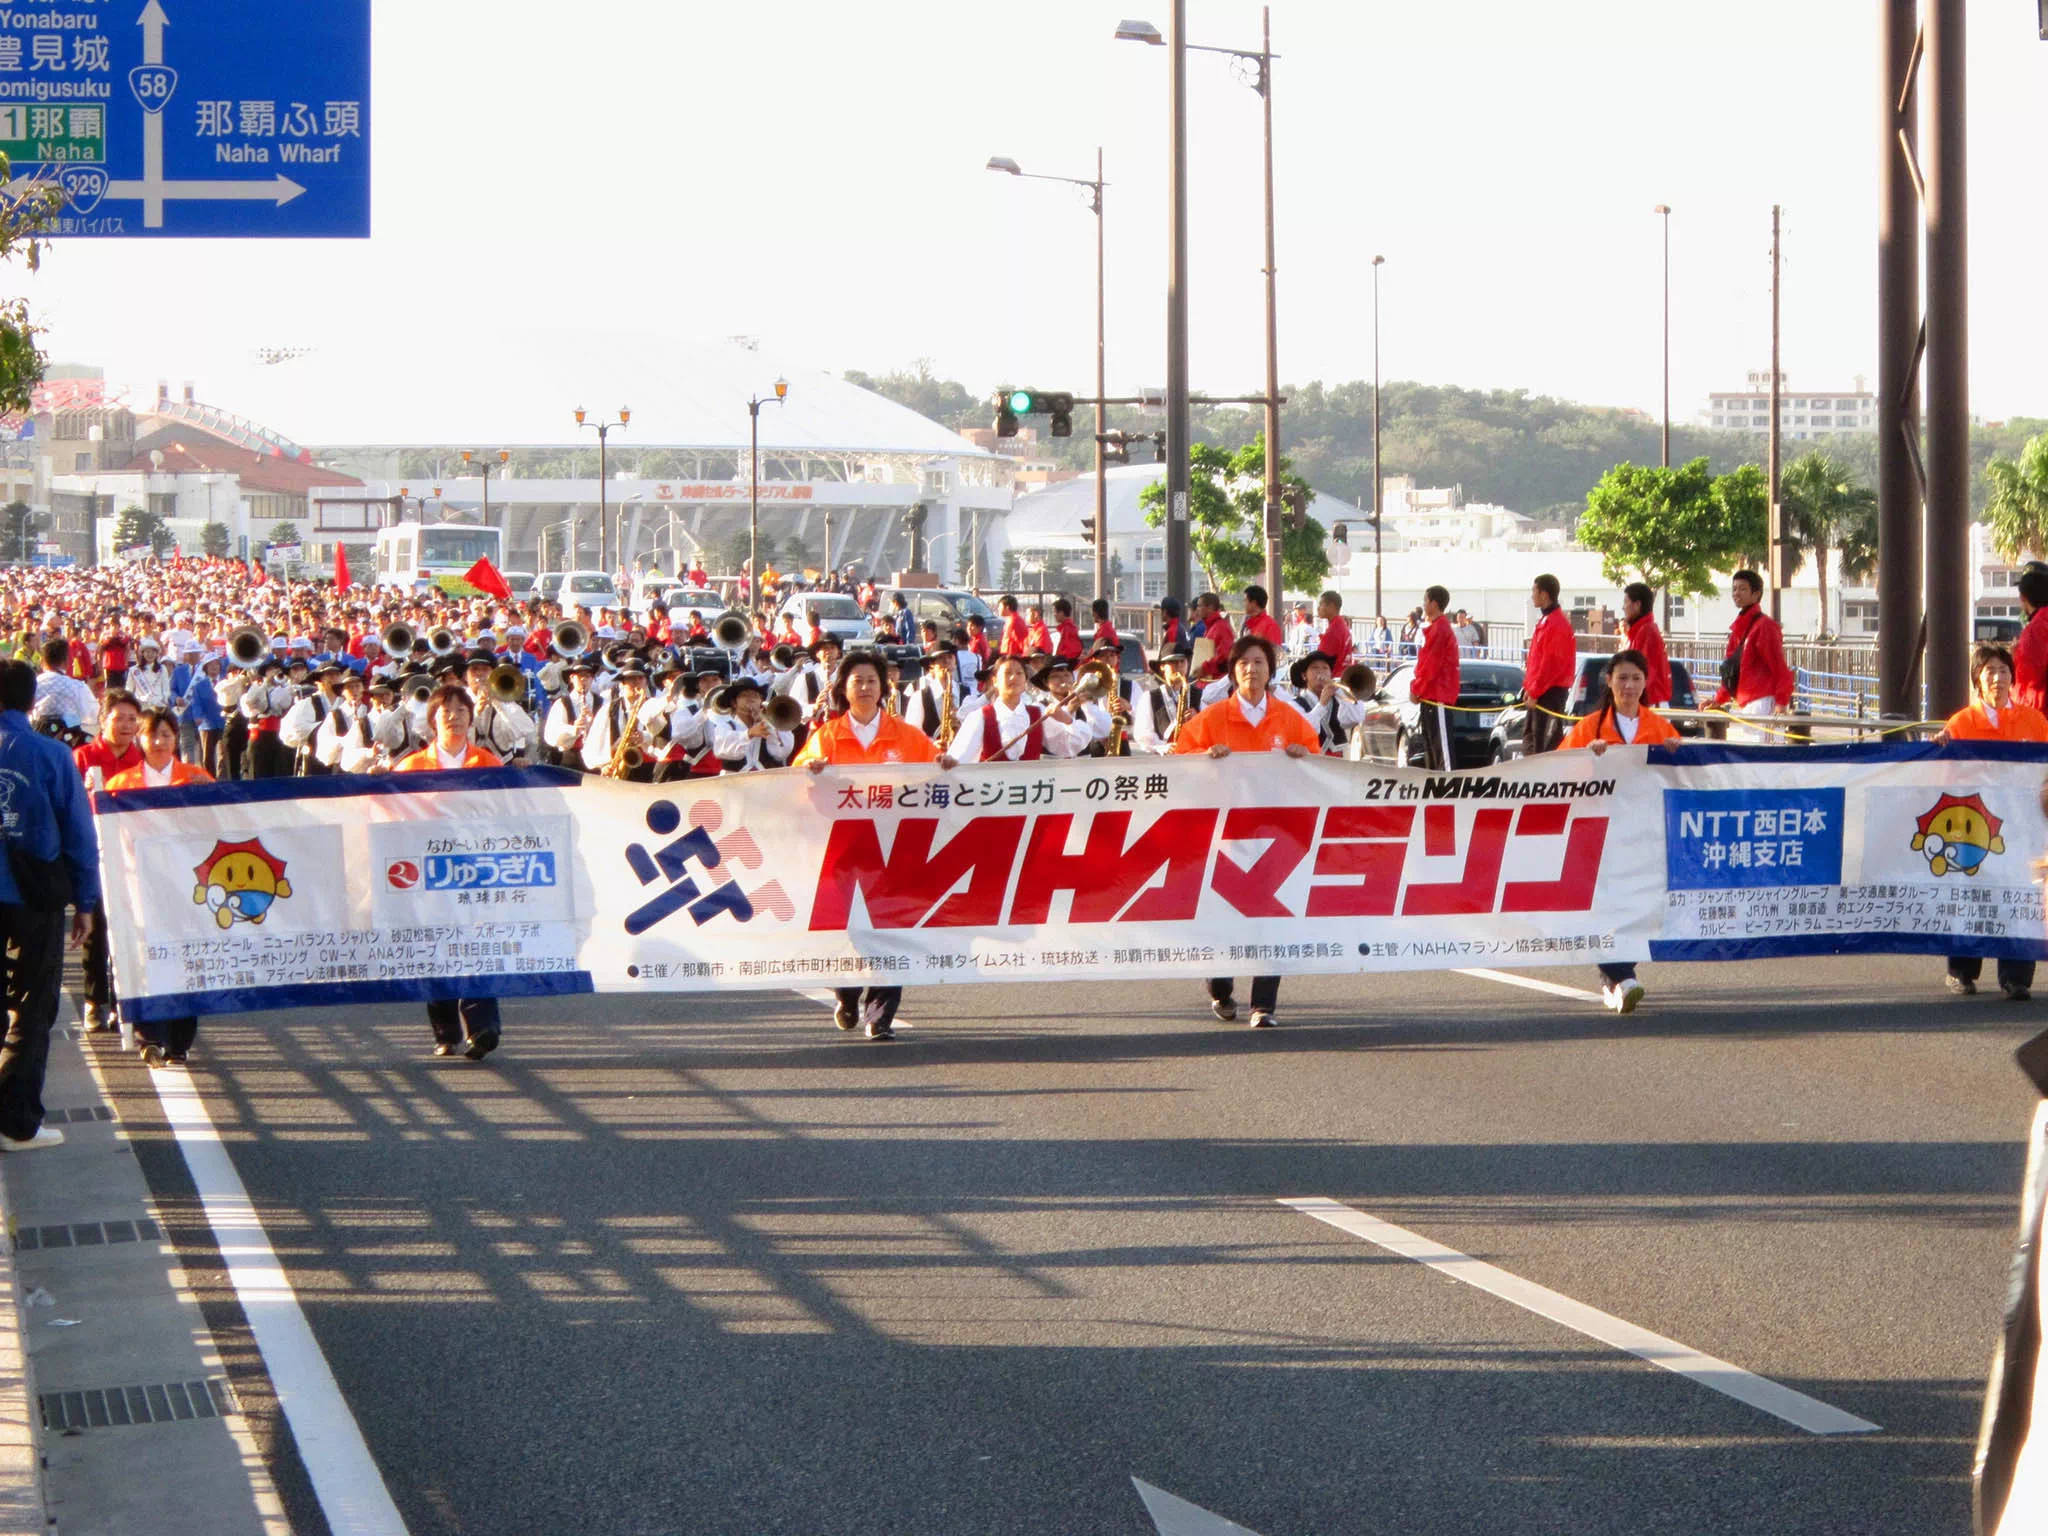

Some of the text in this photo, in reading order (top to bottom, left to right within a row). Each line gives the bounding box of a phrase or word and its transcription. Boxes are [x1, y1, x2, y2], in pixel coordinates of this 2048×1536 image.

[0, 9, 97, 29] Yonabaru
[0, 35, 110, 71] 豊見城
[139, 76, 167, 98] 58
[31, 108, 100, 139] 那覇
[196, 100, 360, 137] 那覇ふ頭
[38, 142, 95, 160] Naha
[216, 143, 342, 163] Naha Wharf
[66, 174, 101, 196] 329
[837, 773, 1169, 809] 太陽と海とジョガーの祭典
[1366, 777, 1616, 799] 27th NAHA MARATHON
[1680, 807, 1828, 839] NTT西日本
[1703, 840, 1804, 869] 沖縄支店
[428, 854, 553, 888] りゅうぎん
[808, 803, 1610, 932] NAHAマラソン
[457, 890, 527, 905] 琉球銀行
[1951, 888, 1992, 903] 日本製紙
[1746, 904, 1778, 918] JR九州
[1700, 923, 1737, 936] カルビー
[1963, 921, 2006, 936] 沖縄電力
[368, 945, 437, 961] ANAグループ
